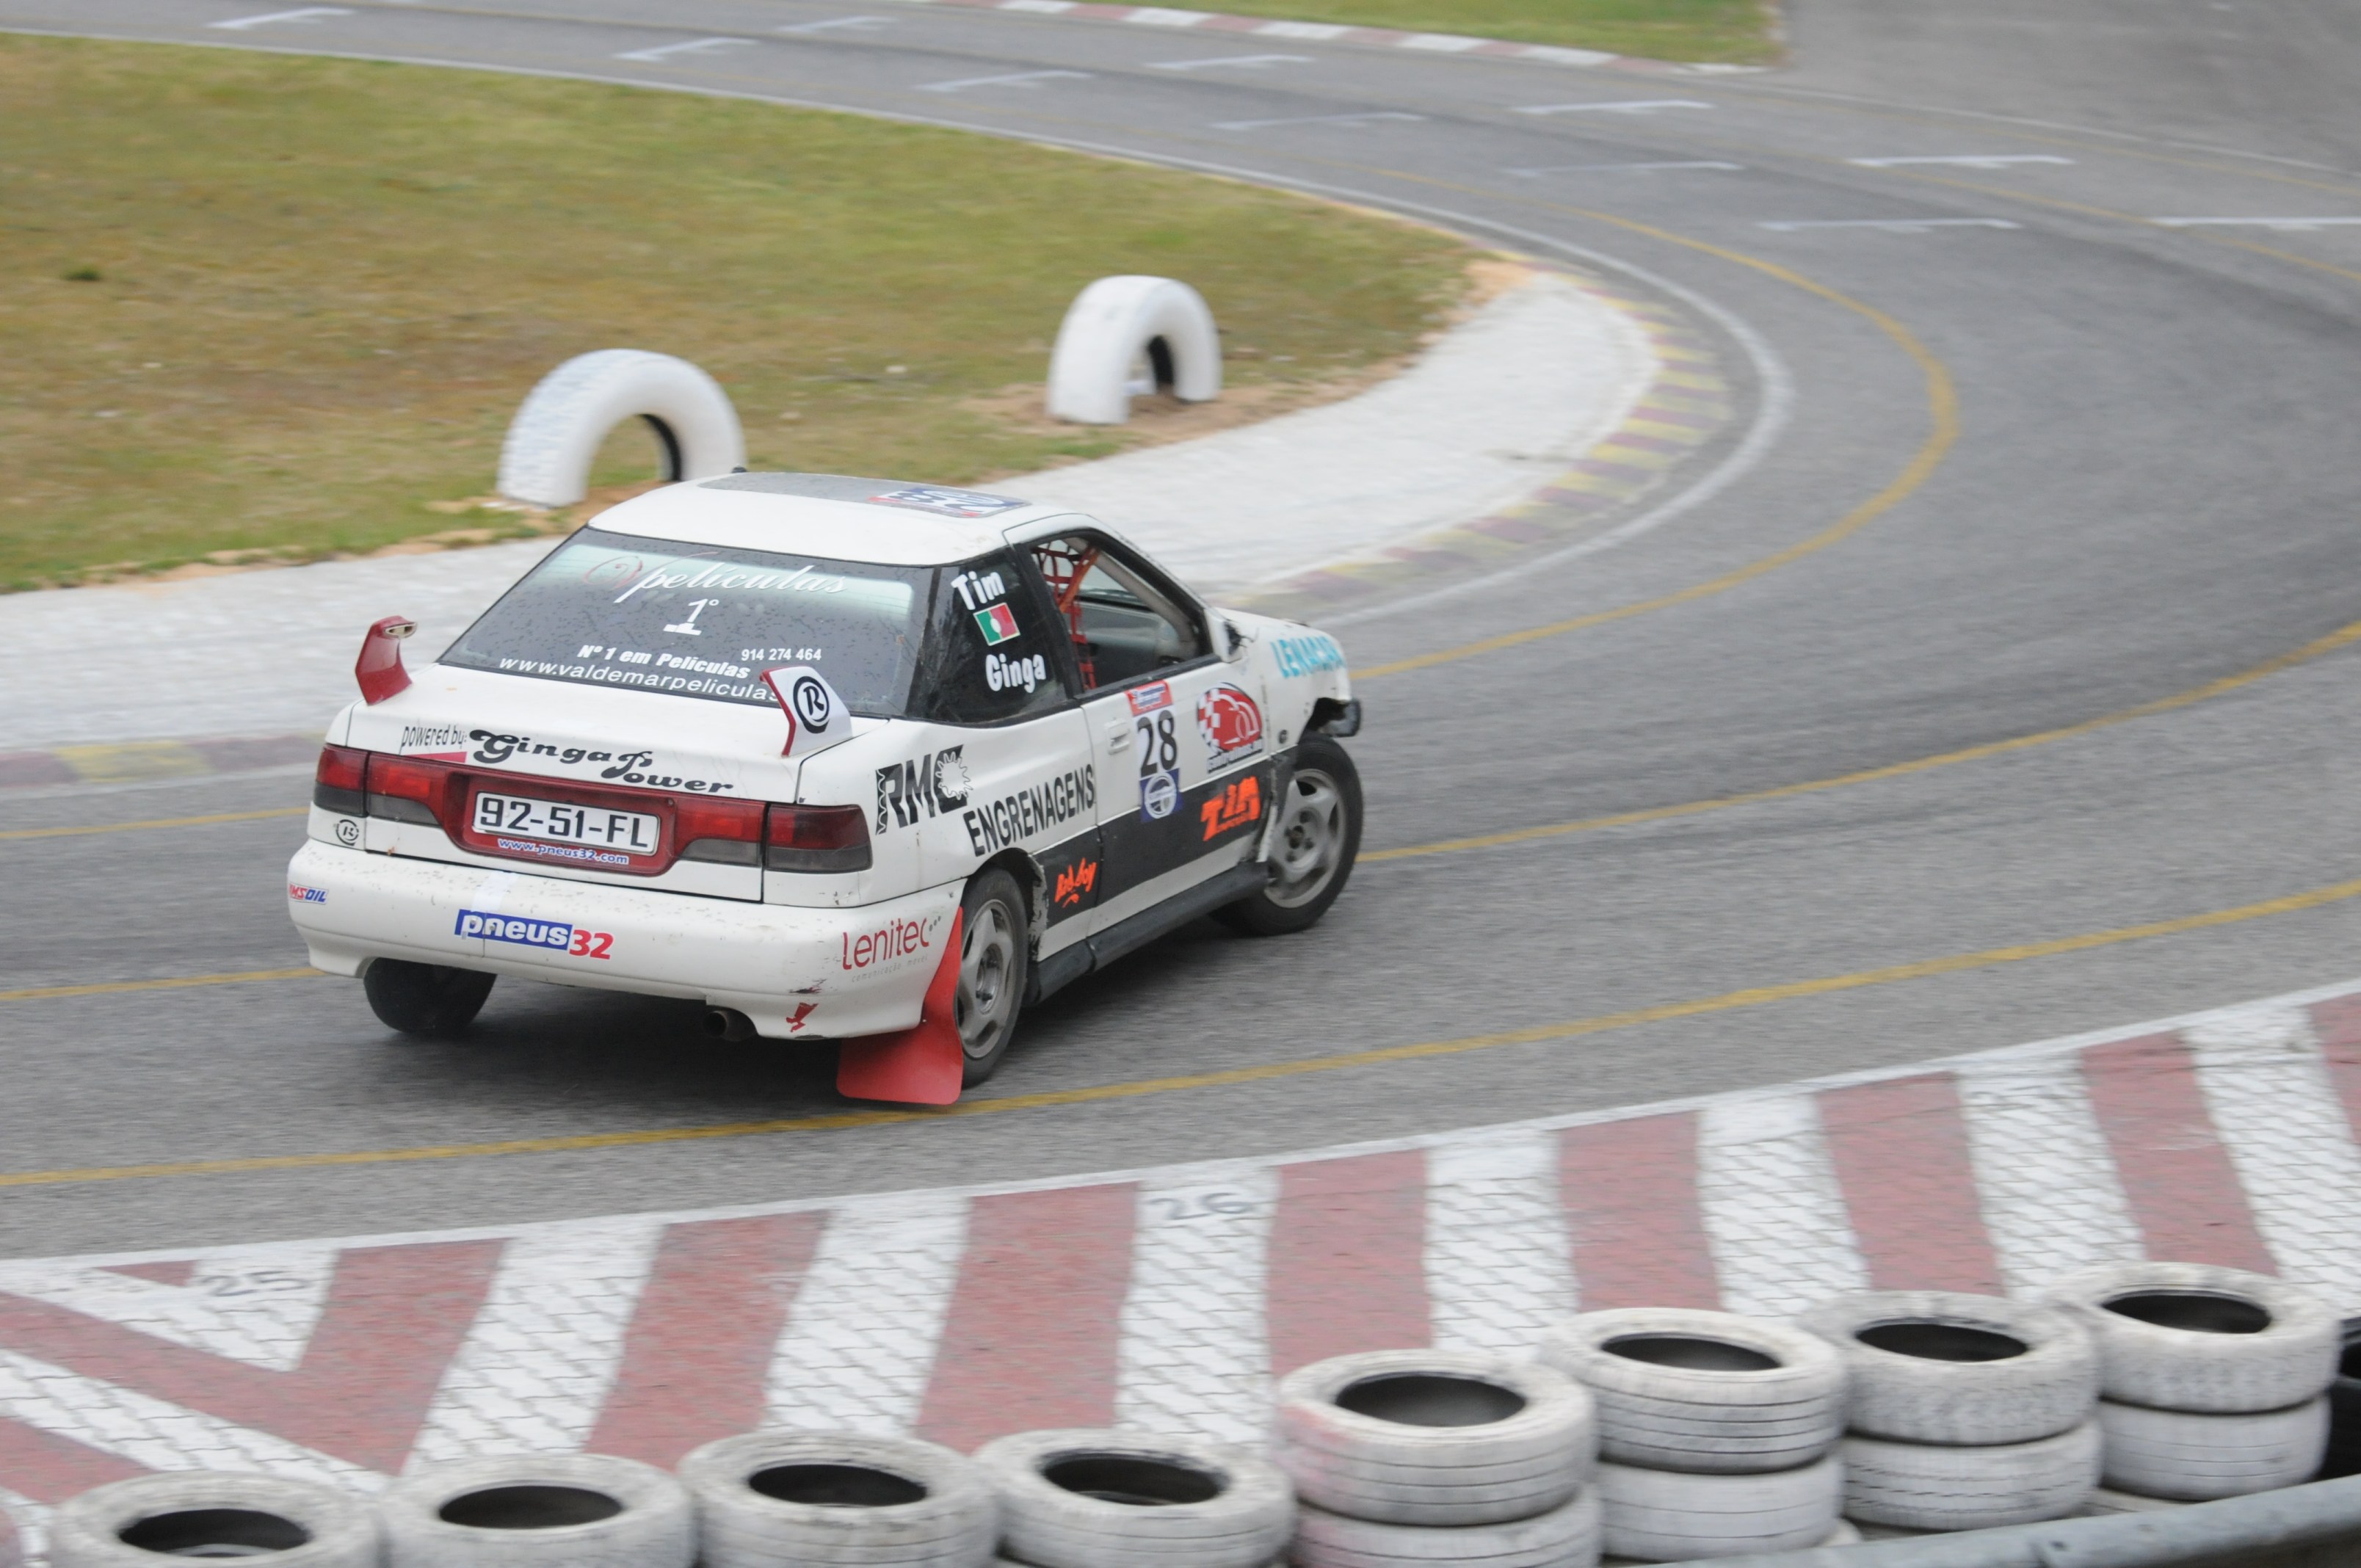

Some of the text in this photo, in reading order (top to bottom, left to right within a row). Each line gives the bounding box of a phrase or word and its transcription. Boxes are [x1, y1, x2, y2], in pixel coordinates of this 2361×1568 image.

[951, 570, 1006, 610] Tim
[619, 650, 653, 665] em
[741, 648, 822, 661] 914 274 464
[985, 653, 1046, 693] Ginga
[400, 725, 450, 748] powered
[469, 729, 612, 764] Ginga
[601, 750, 733, 793] Power
[1136, 709, 1178, 778] 28
[875, 744, 971, 835] RMC
[963, 763, 1095, 857] ENGRENAGENS
[480, 797, 648, 848] 92-51-FL
[498, 839, 629, 865] www.pneus32.com
